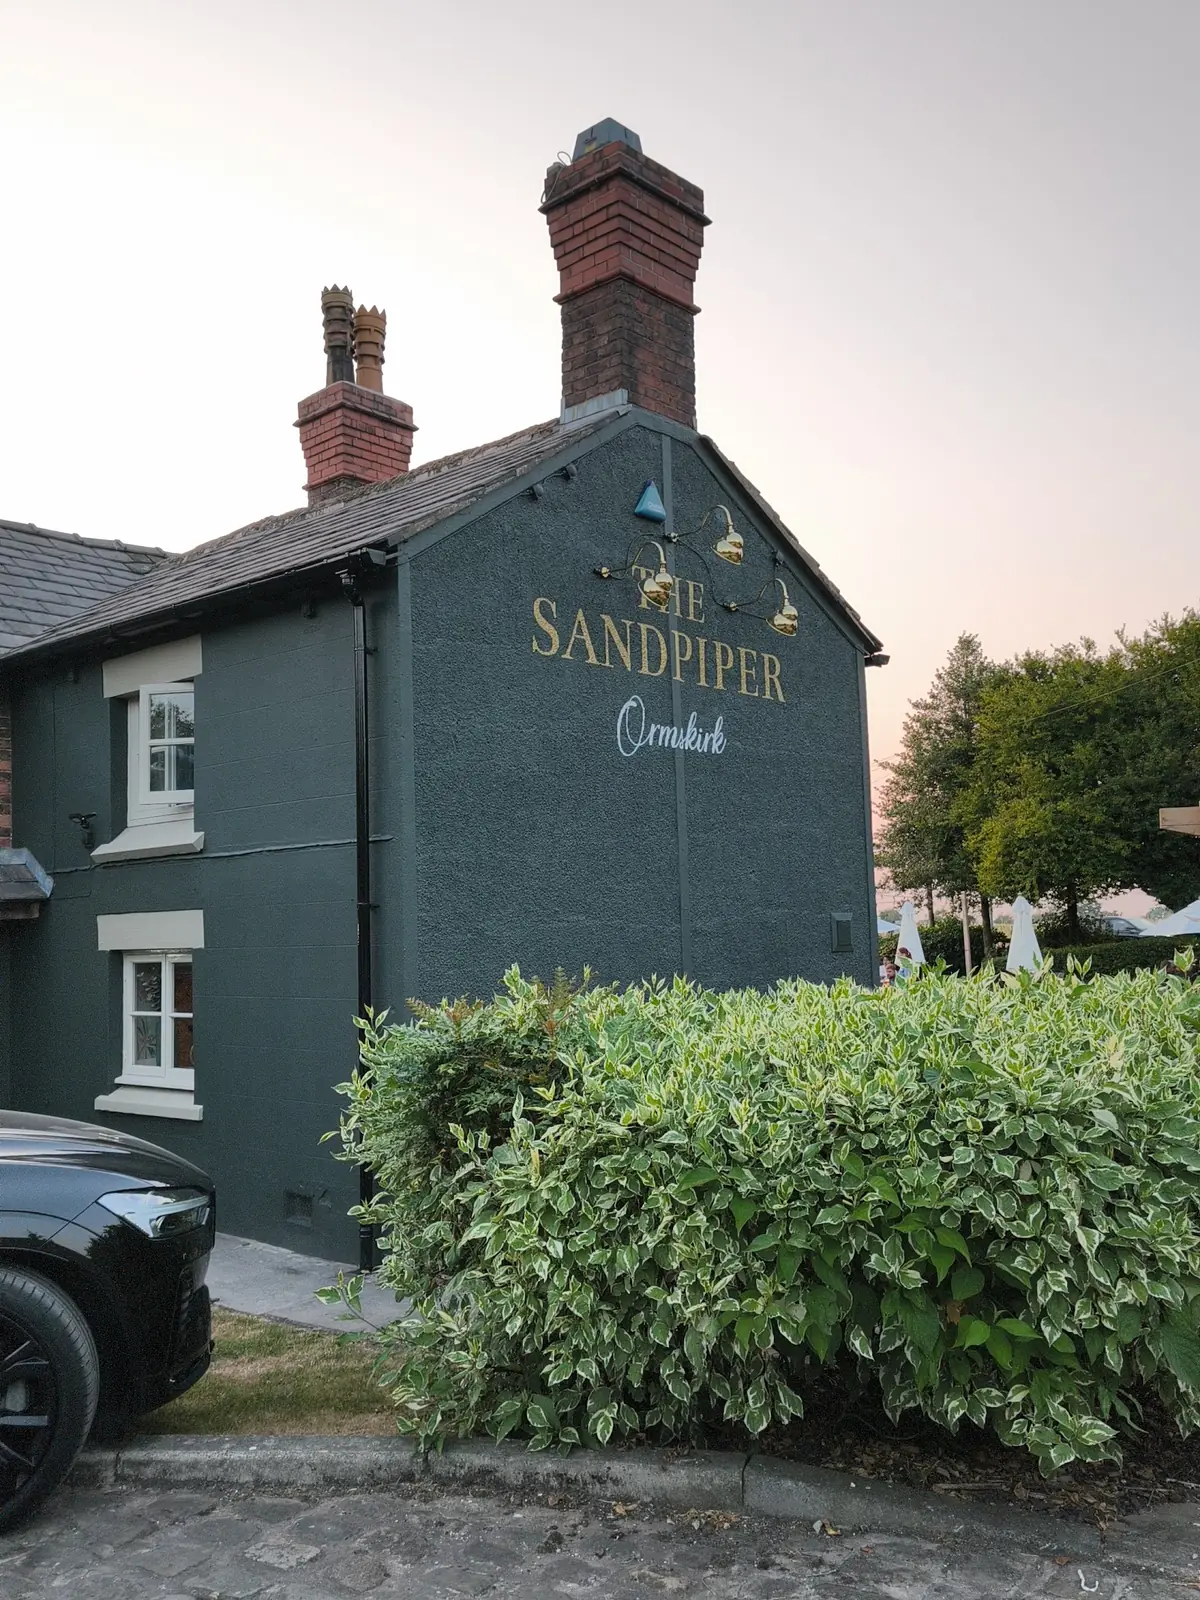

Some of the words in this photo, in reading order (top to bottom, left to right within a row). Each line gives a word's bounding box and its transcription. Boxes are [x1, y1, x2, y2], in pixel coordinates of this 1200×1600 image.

[631, 564, 705, 623] THE
[532, 597, 786, 702] SANDPIPER
[617, 695, 727, 756] Ormskirk
